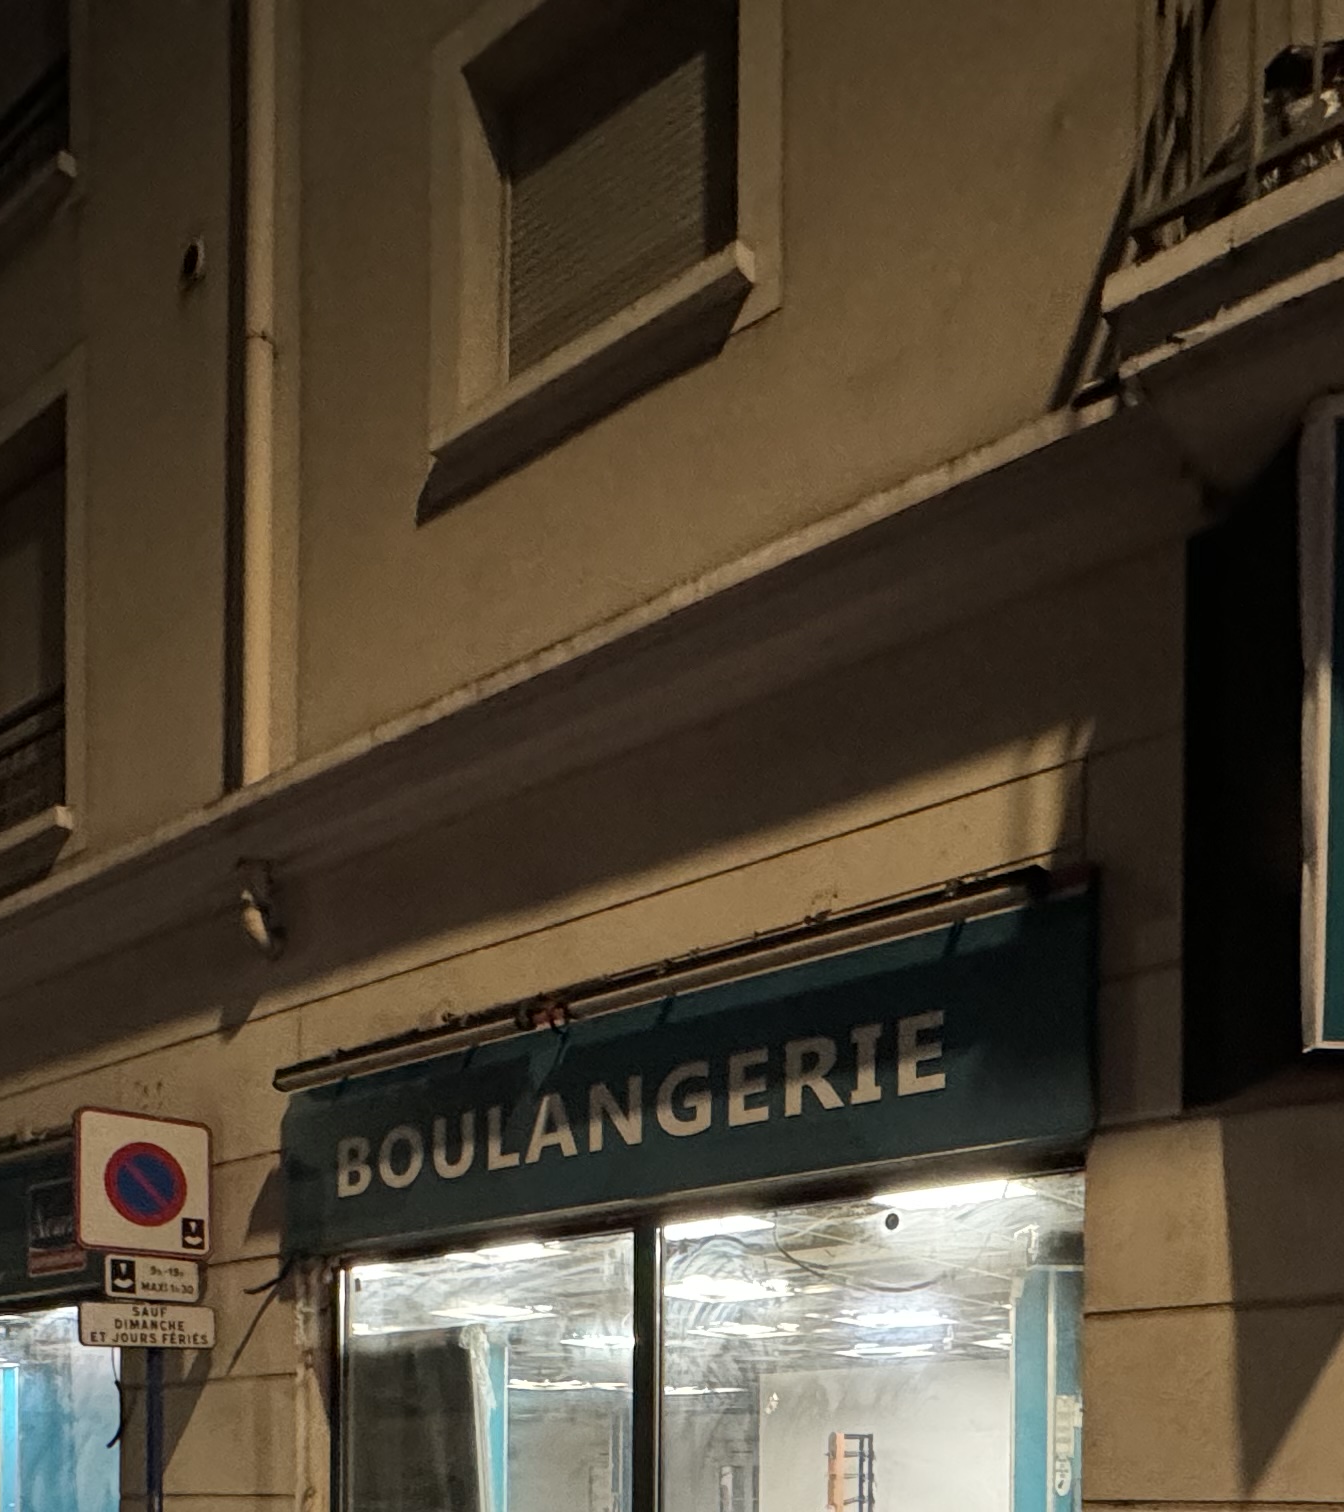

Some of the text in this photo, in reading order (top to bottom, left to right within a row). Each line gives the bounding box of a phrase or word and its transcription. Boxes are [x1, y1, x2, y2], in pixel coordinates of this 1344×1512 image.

[336, 1010, 948, 1200] BOULANGERIE
[132, 1306, 168, 1318] SAUF
[114, 1318, 186, 1332] DIMANCHE
[90, 1331, 107, 1343] ET
[111, 1332, 157, 1344] JOURS
